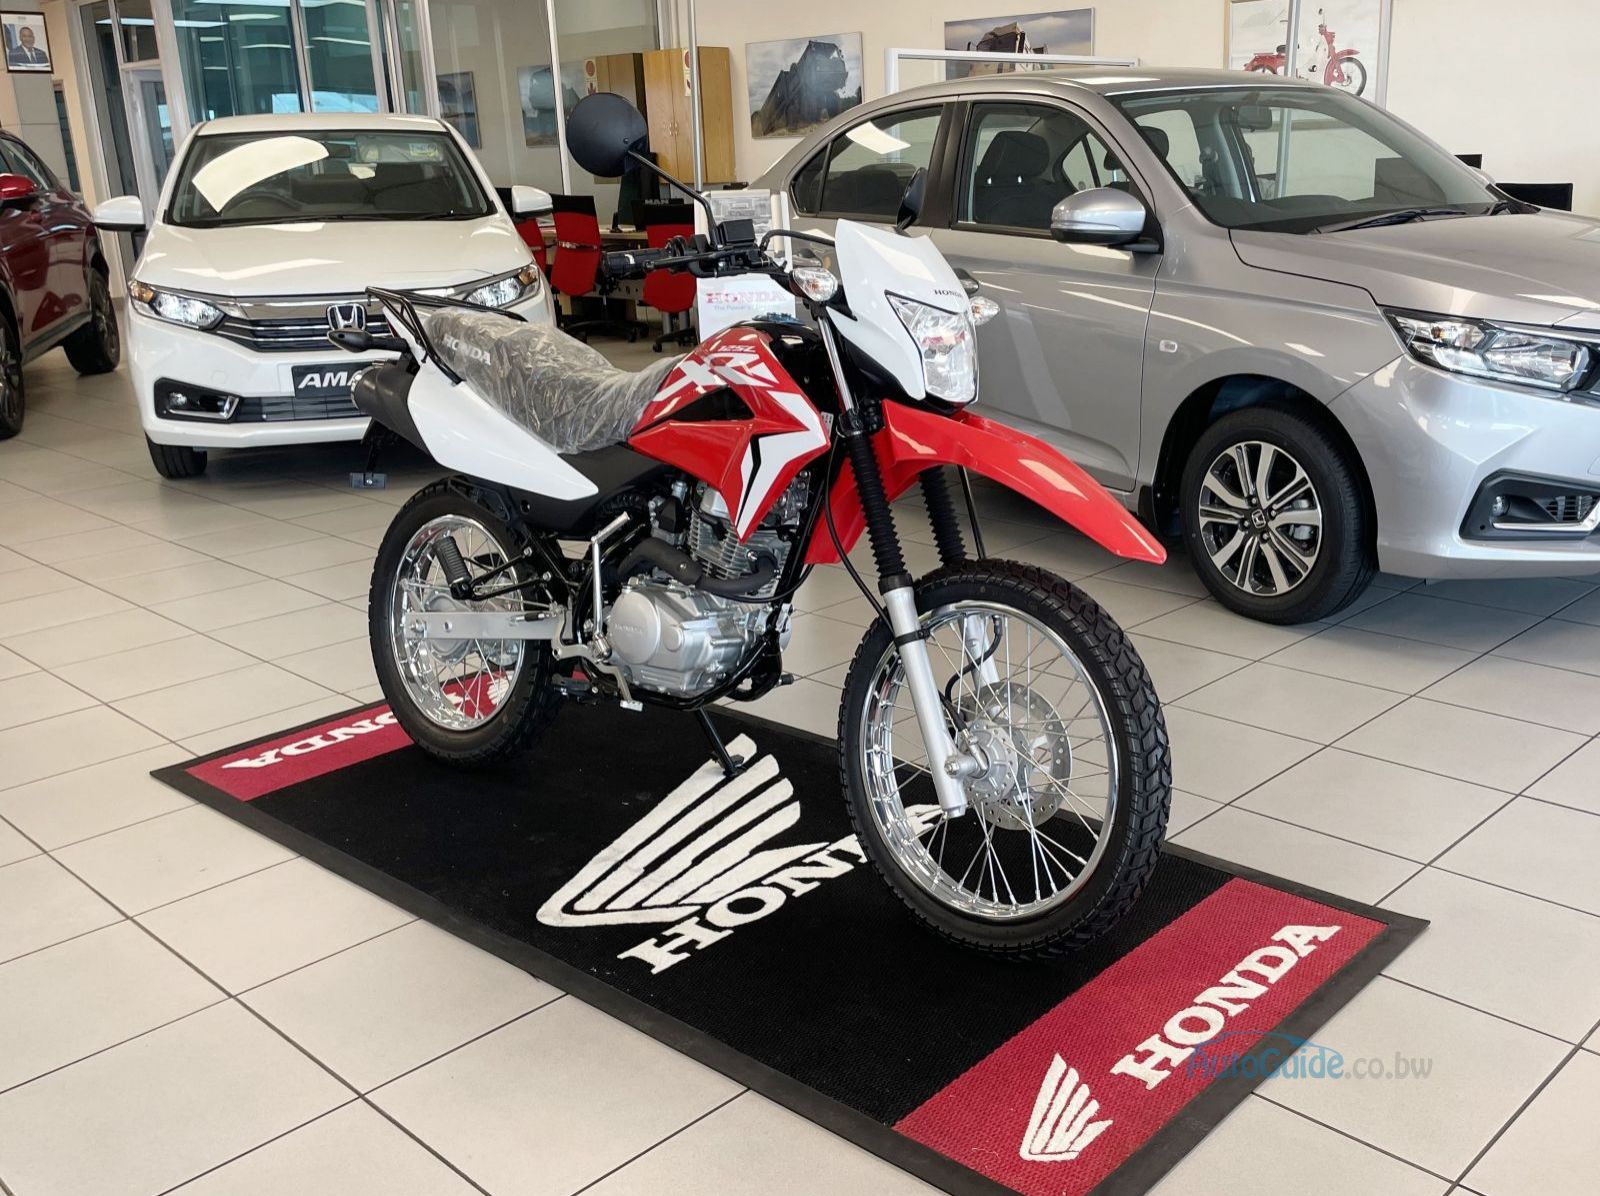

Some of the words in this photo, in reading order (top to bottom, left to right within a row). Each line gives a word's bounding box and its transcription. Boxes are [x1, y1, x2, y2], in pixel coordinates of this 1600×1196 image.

[706, 291, 785, 304] HONDA
[443, 334, 492, 366] HONDA
[1110, 925, 1342, 1091] HONDA
